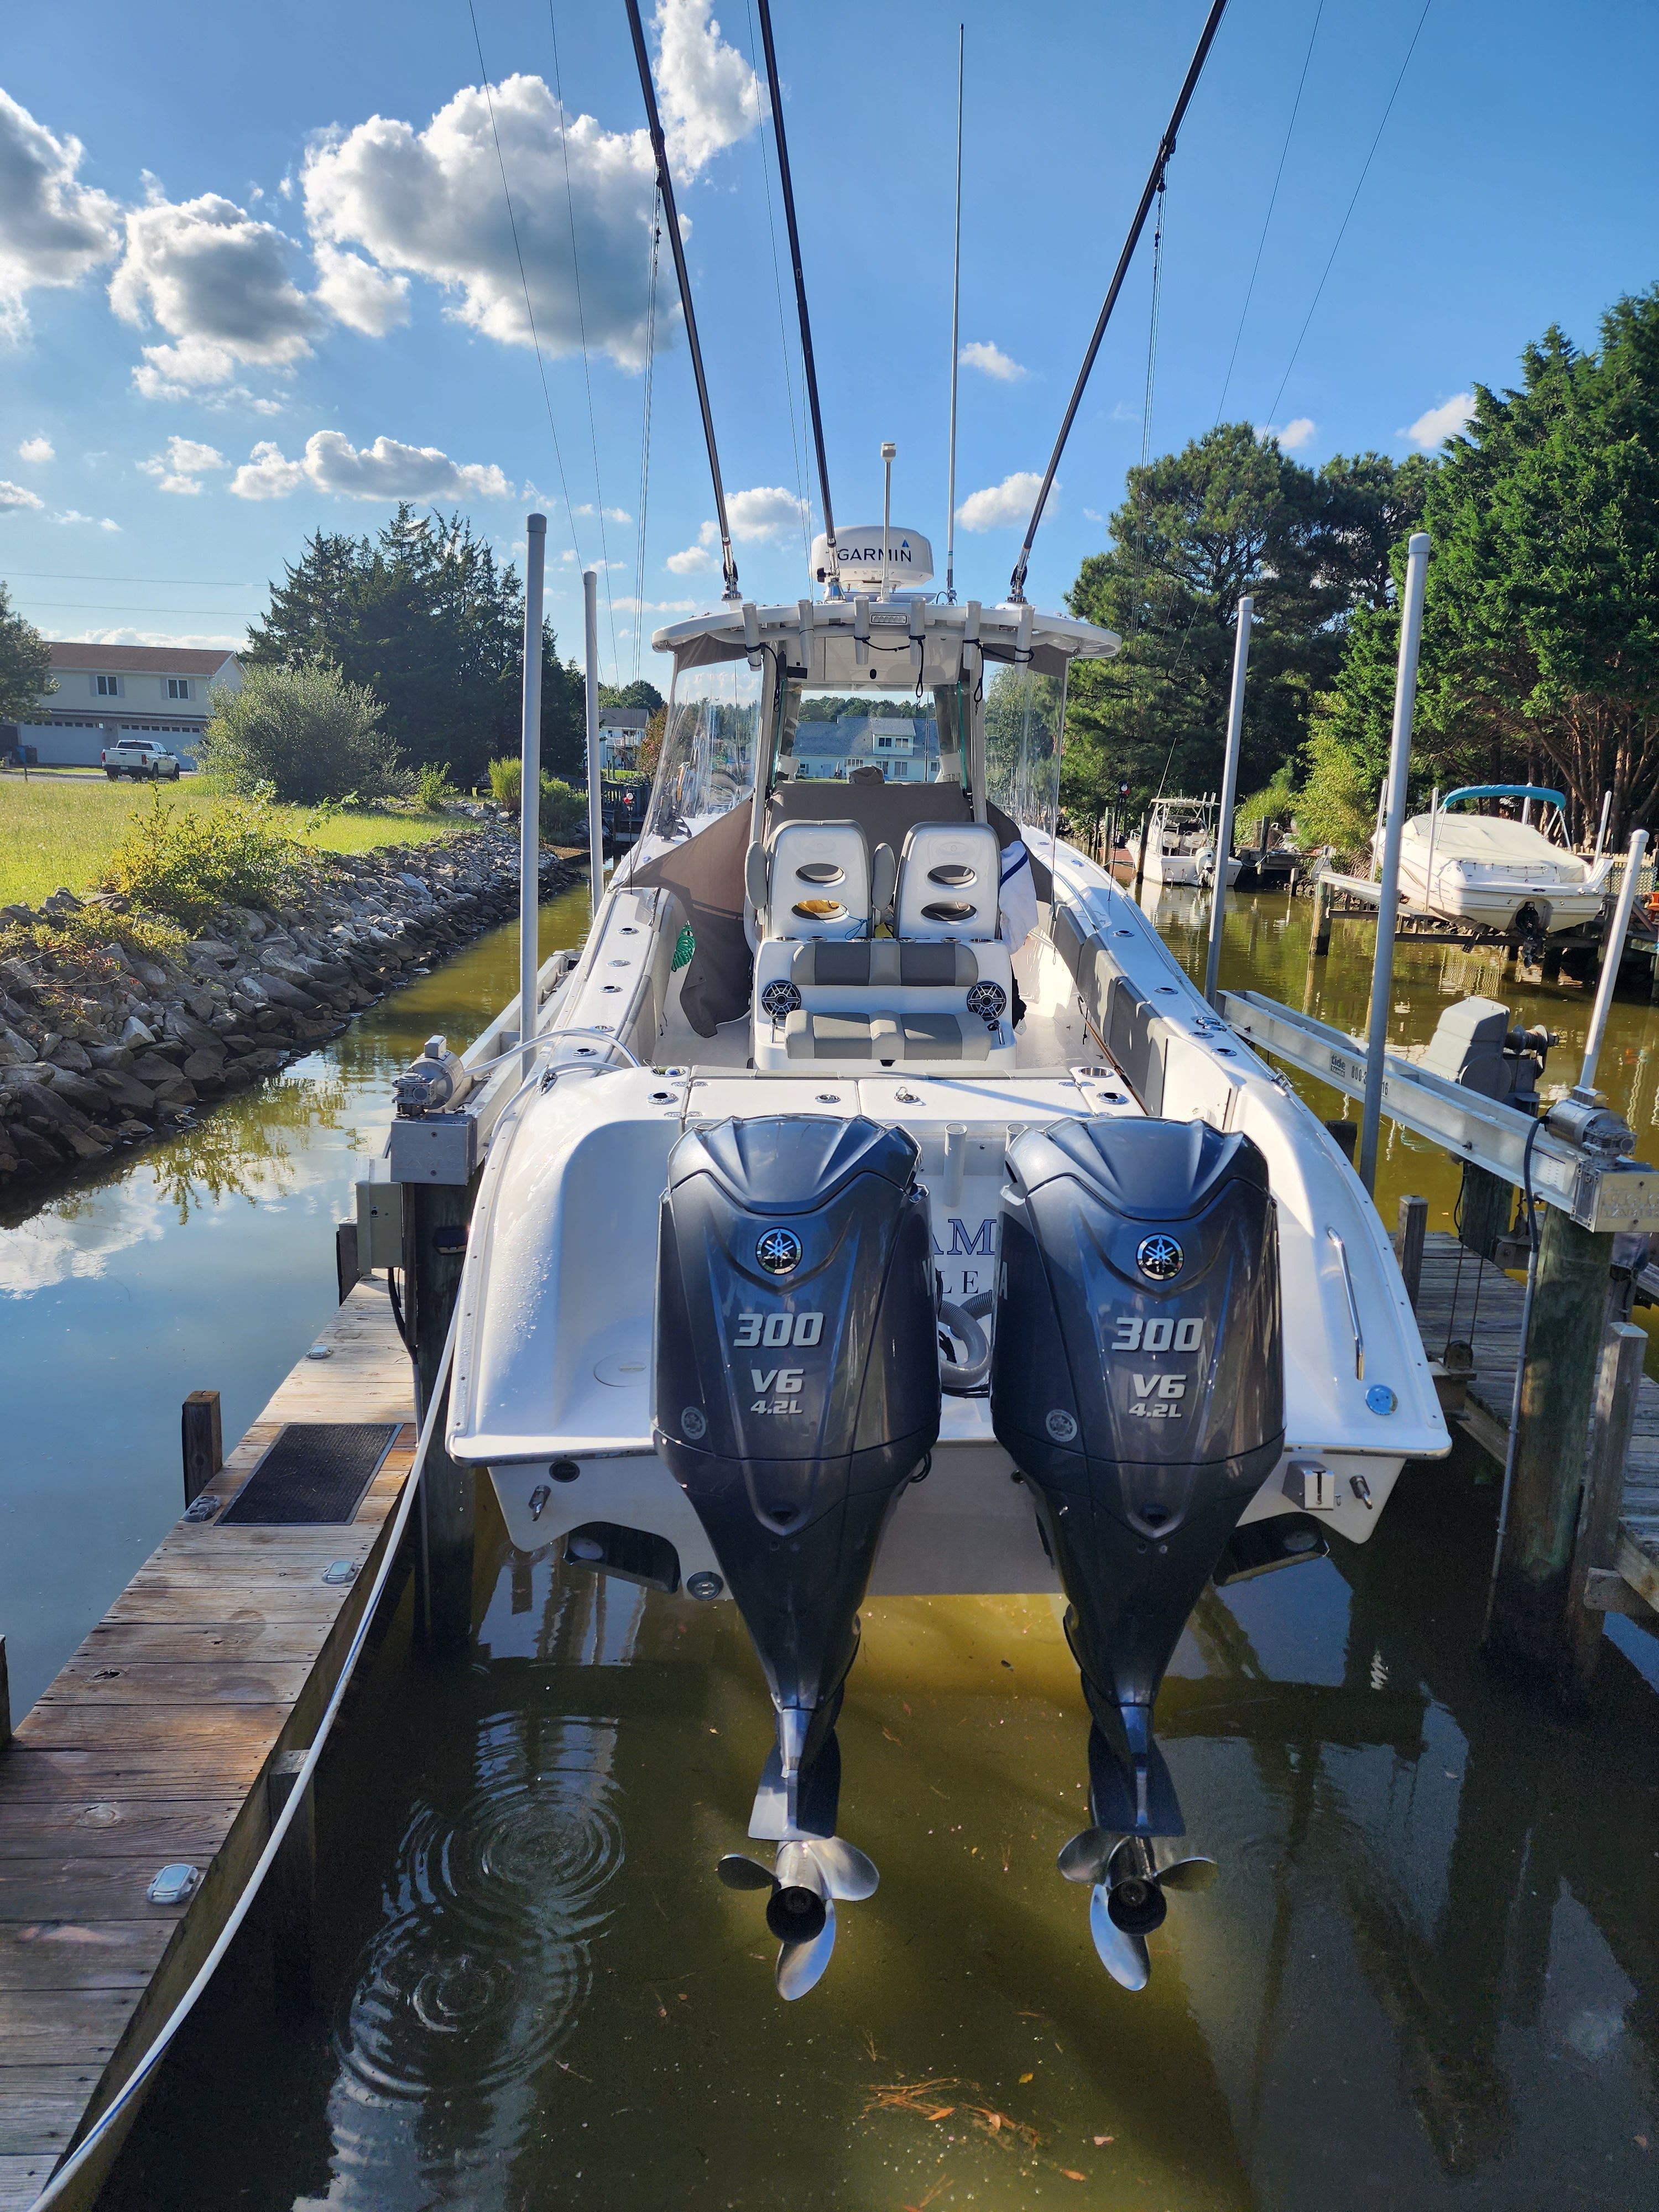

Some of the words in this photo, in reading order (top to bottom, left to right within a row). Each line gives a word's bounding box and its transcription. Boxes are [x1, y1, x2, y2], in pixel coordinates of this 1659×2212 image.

[837, 548, 911, 562] GARMIN
[733, 1312, 825, 1347] 300
[1111, 1317, 1205, 1352] 300
[750, 1368, 805, 1394] V6
[1133, 1374, 1187, 1399] V6
[750, 1400, 804, 1415] 4.2L
[1128, 1402, 1182, 1418] 4.2L
